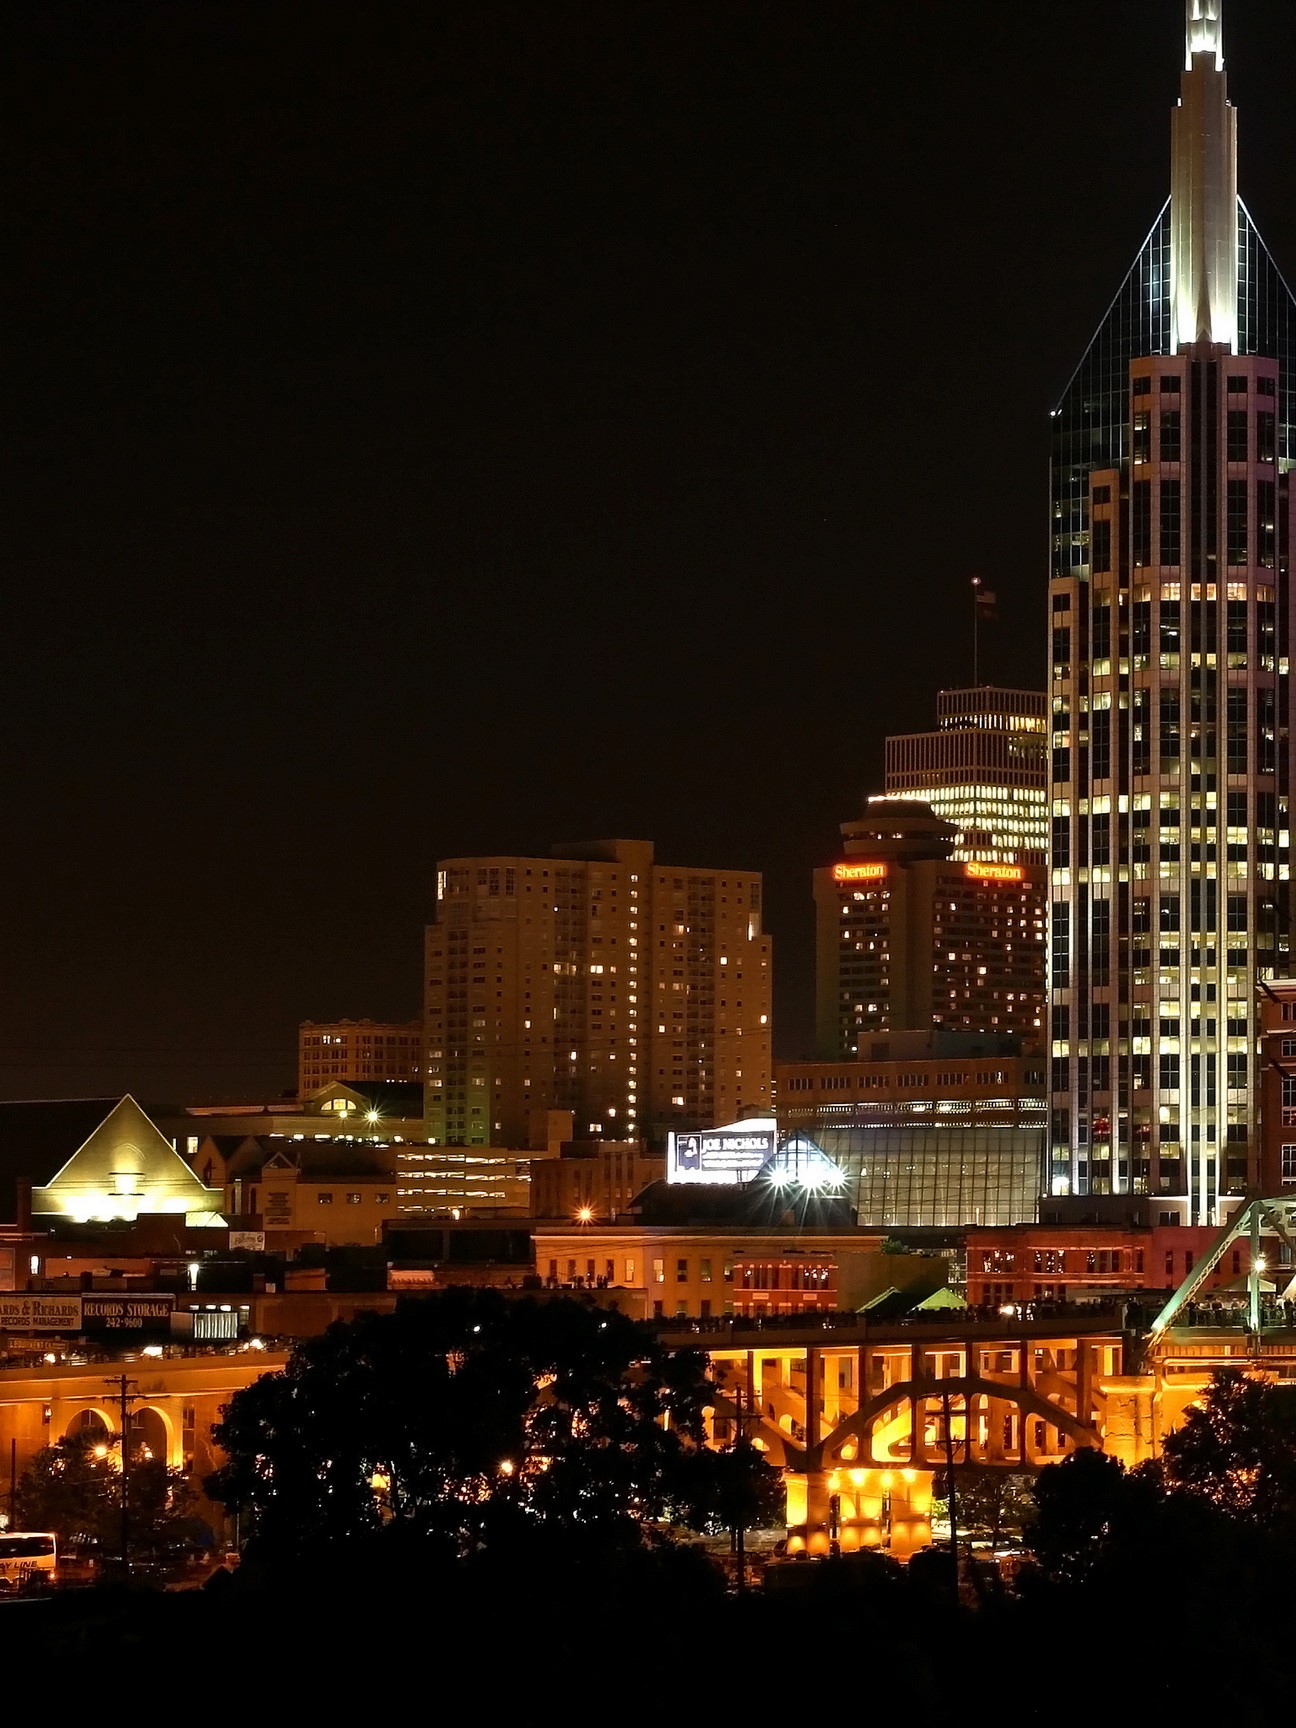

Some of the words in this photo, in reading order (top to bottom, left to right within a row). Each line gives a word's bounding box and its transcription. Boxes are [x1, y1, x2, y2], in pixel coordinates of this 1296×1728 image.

[834, 863, 885, 879] Sheraton
[966, 862, 1022, 879] Sheraton
[701, 1138, 721, 1154] JOE
[722, 1138, 768, 1150] NICHOLS
[84, 1303, 124, 1316] RECORDS
[127, 1303, 169, 1317] STORAGE
[0, 1317, 30, 1326] RECORDS
[32, 1317, 74, 1327] MANAGEMENT
[14, 1561, 38, 1569] LINE
